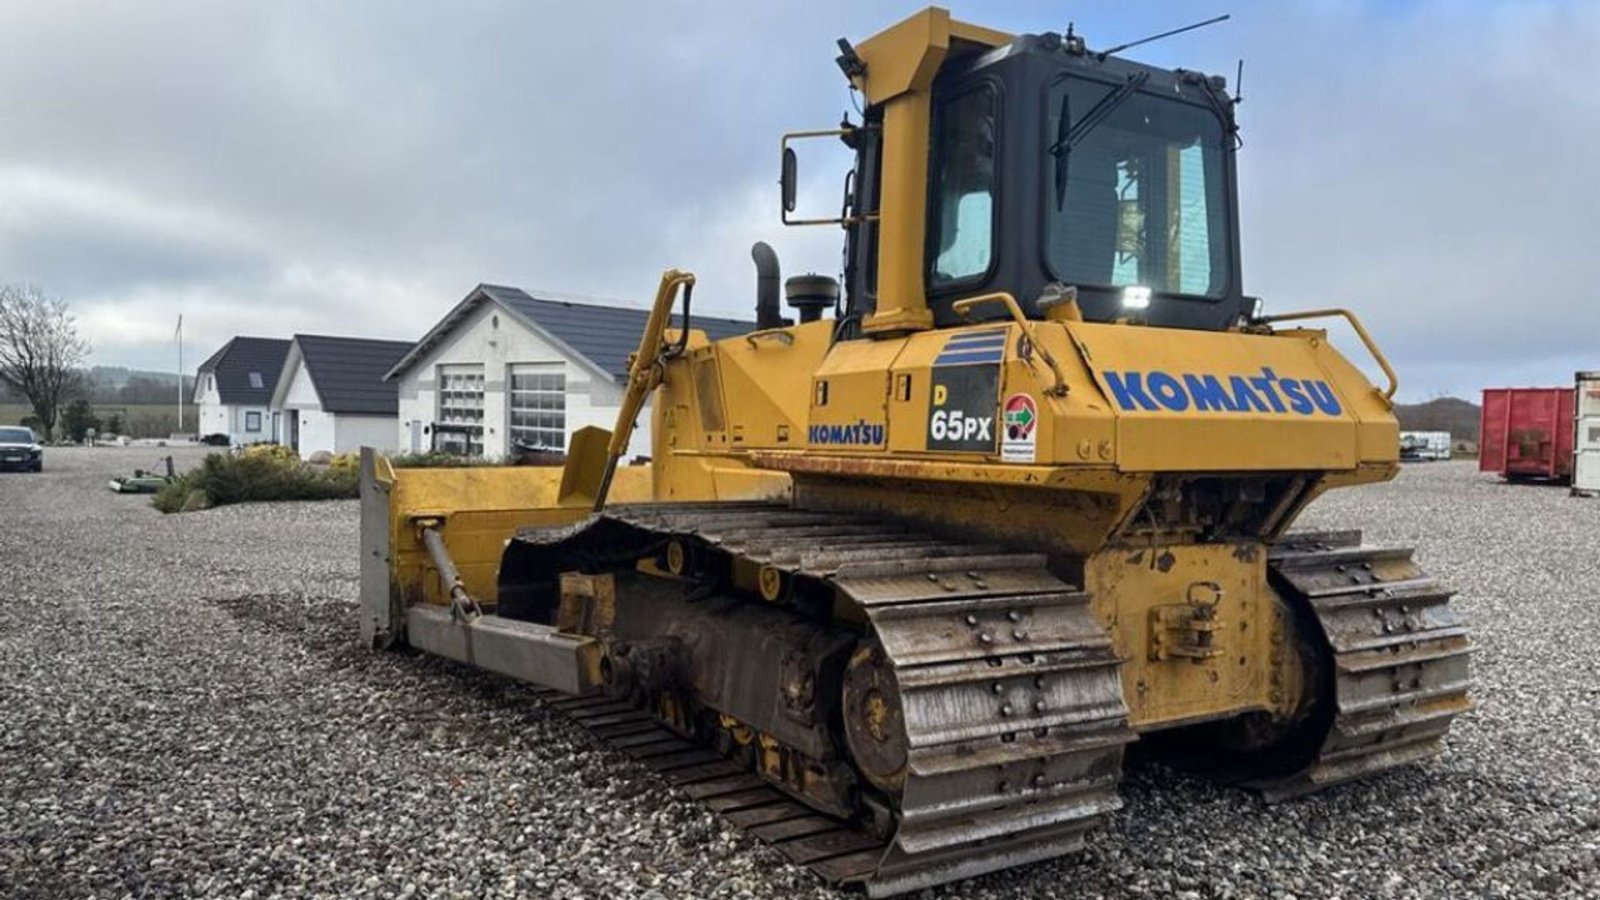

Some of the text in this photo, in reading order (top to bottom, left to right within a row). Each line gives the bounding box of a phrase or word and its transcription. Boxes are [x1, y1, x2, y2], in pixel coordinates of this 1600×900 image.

[933, 385, 947, 405] D
[1104, 367, 1342, 416] KOMATSU
[809, 420, 883, 445] KOMATSU
[931, 411, 992, 441] 65PX
